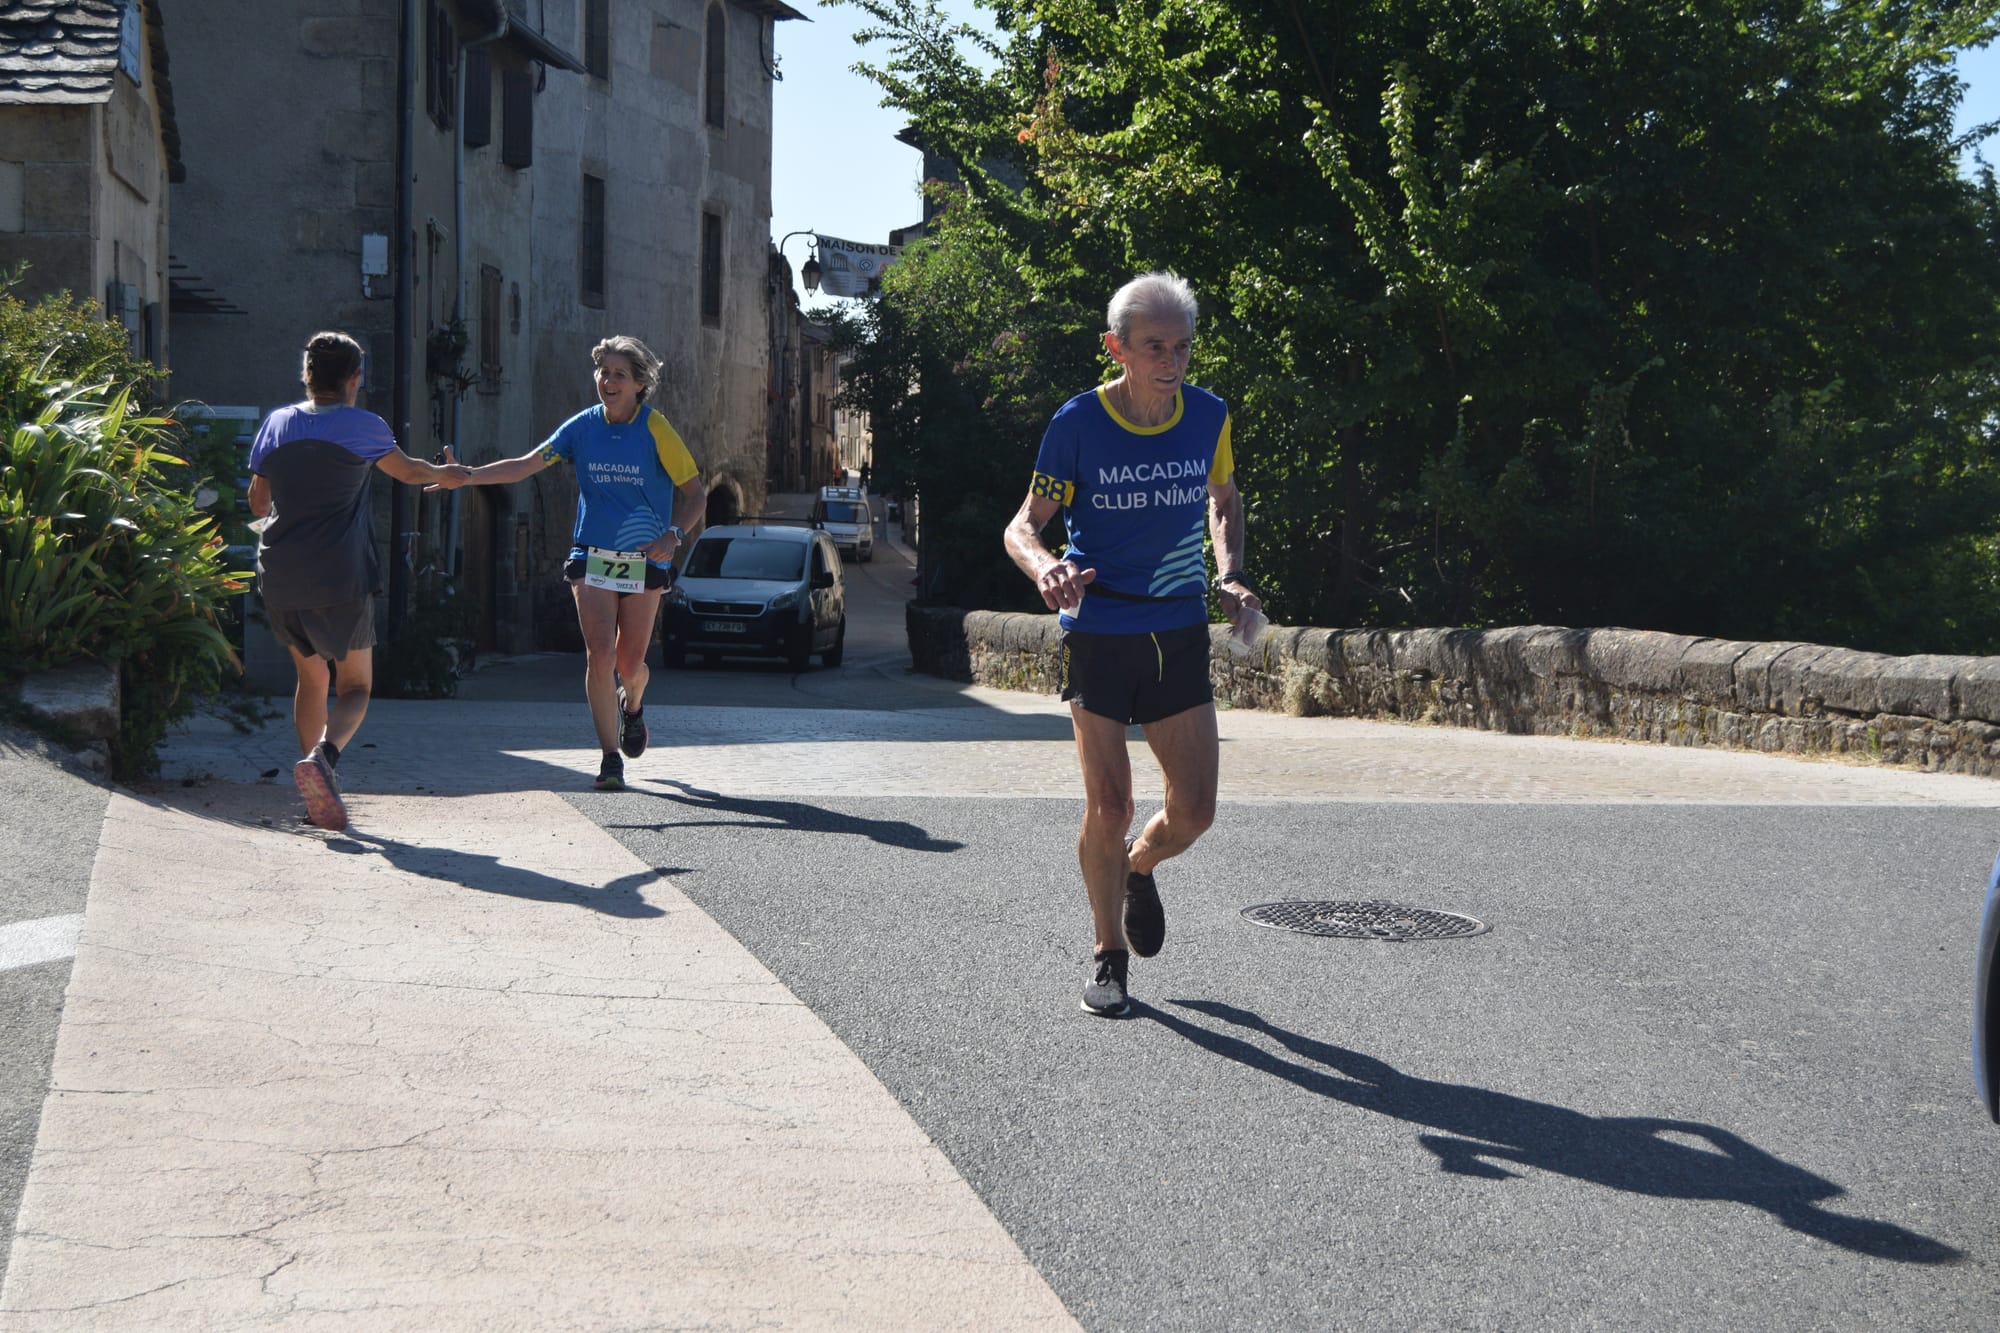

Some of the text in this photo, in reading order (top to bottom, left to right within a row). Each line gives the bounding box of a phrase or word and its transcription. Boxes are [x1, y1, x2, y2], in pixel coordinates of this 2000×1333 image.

[821, 239, 875, 254] MAISON
[879, 246, 896, 256] DE
[589, 463, 640, 474] MACADAM
[1099, 459, 1206, 484] MACADAM
[1032, 474, 1066, 502] 88
[1092, 492, 1147, 509] CLUB
[603, 560, 630, 579] 72
